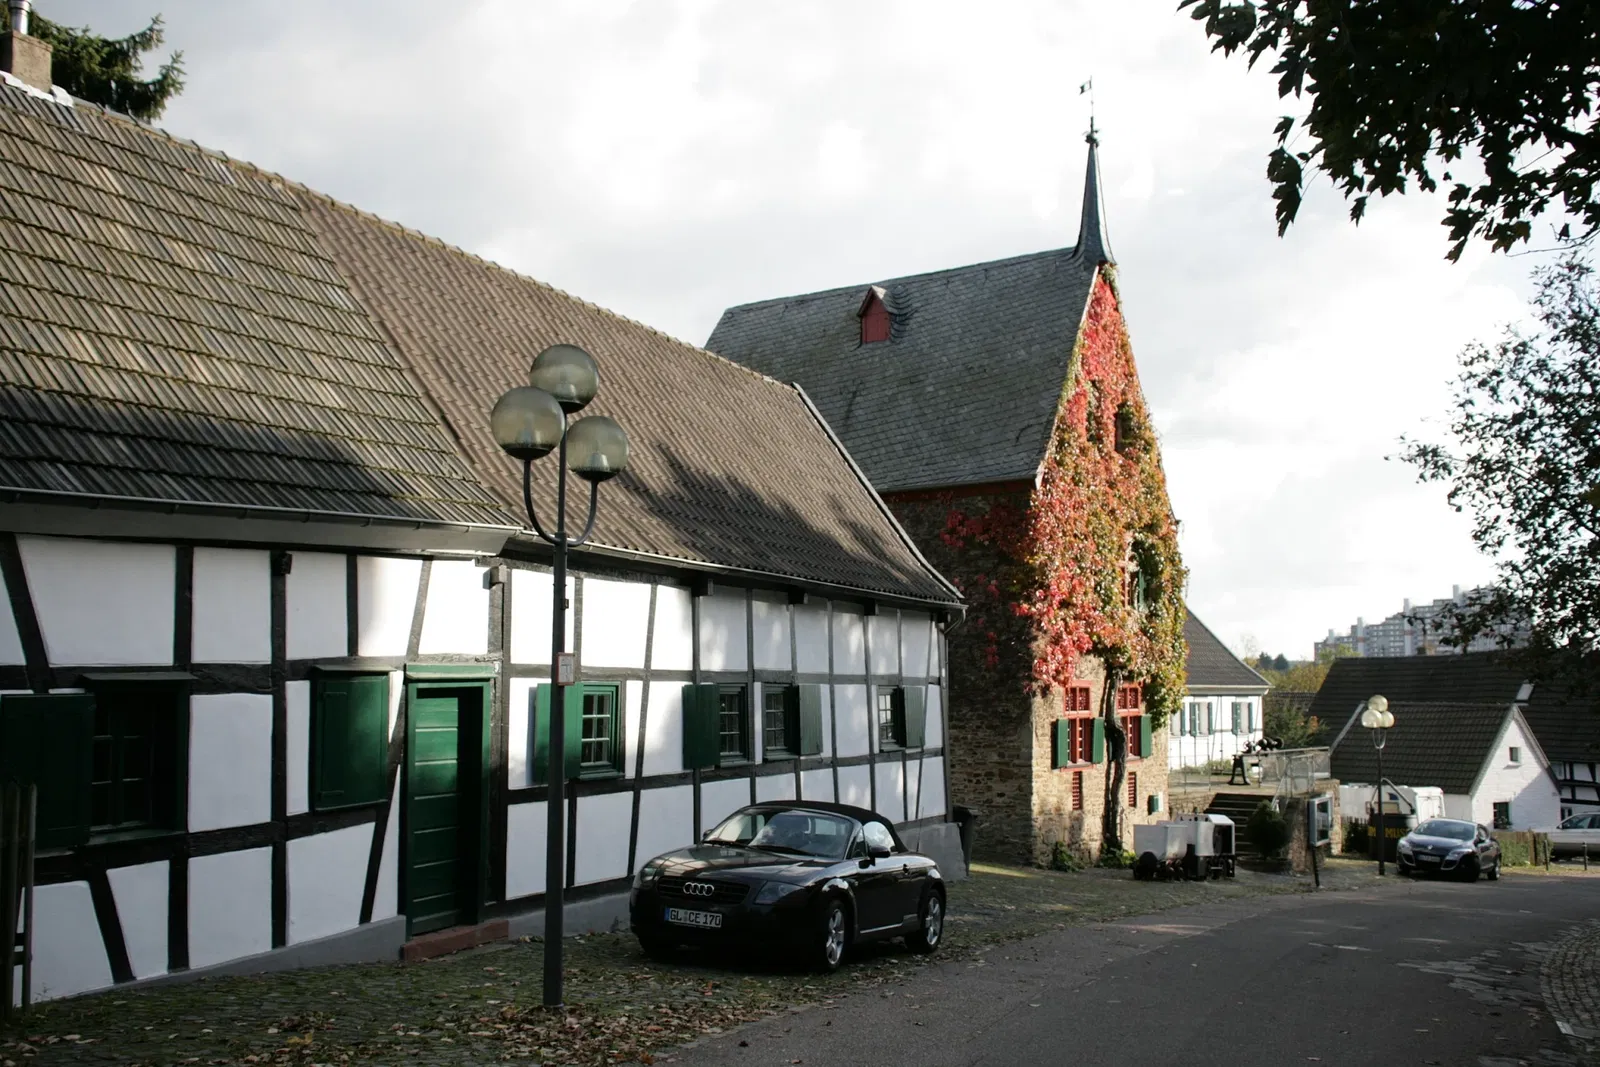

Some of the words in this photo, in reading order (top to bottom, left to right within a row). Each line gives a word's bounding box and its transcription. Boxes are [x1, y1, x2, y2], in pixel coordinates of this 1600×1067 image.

[670, 909, 682, 921] GL
[689, 912, 701, 923] CE
[702, 914, 721, 926] 170
